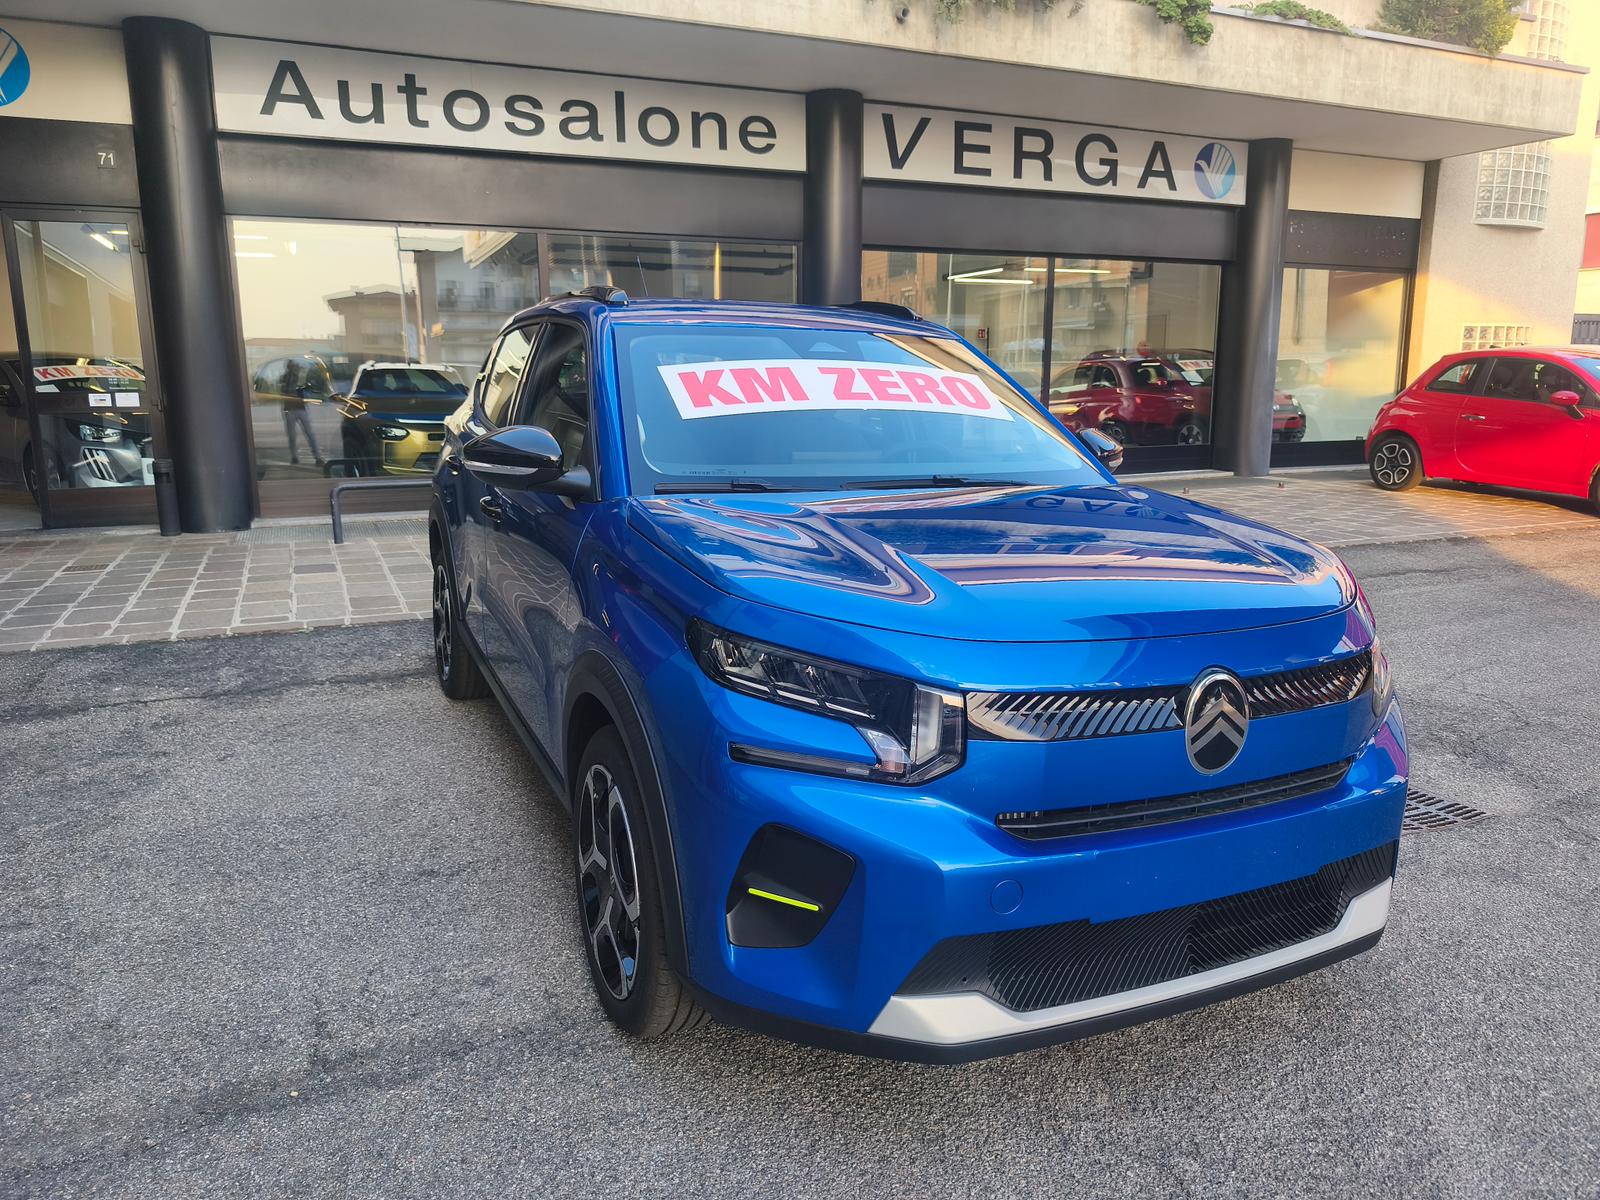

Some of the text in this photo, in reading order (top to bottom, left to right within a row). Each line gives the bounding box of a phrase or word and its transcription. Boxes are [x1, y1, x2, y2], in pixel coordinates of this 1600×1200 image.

[260, 59, 1177, 191] Autosalone VERGA
[97, 152, 114, 166] 71
[35, 366, 76, 379] KM
[678, 366, 992, 410] KM ZERO
